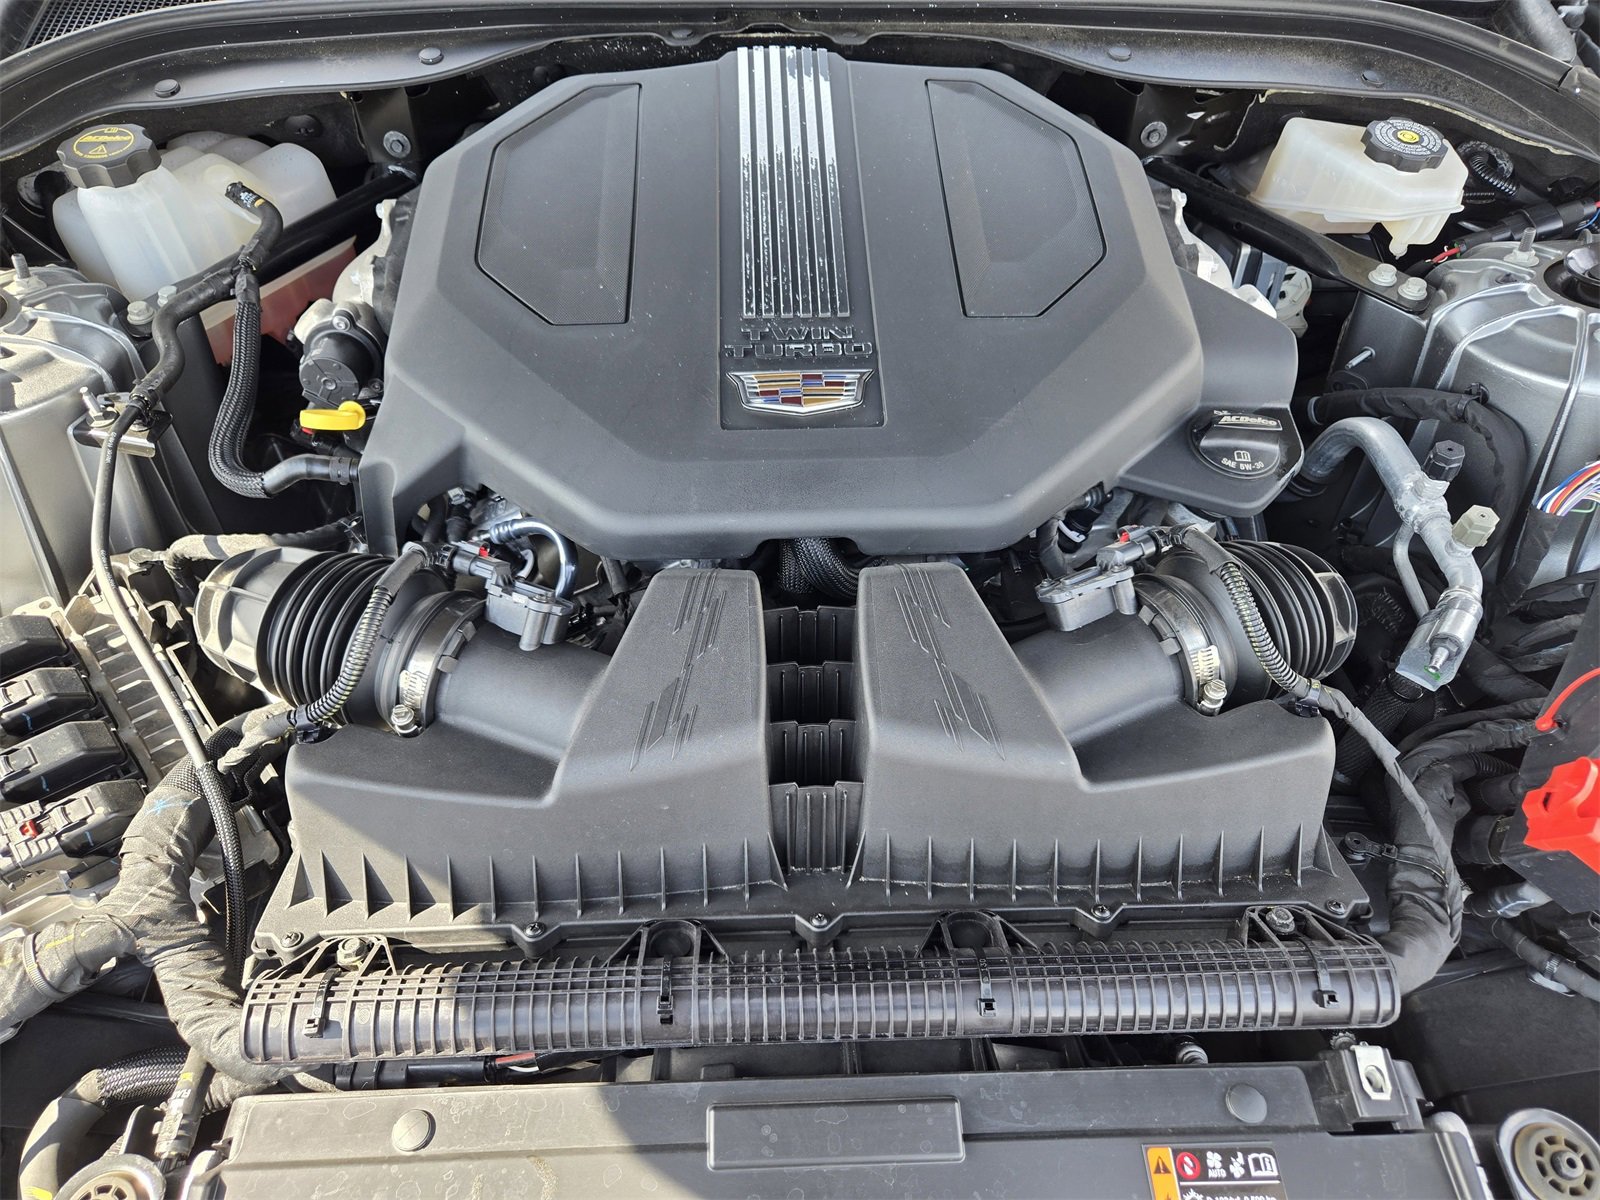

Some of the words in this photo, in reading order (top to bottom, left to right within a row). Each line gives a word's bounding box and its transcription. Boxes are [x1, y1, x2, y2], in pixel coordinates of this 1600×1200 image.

[741, 325, 853, 341] TWIN
[725, 342, 873, 357] TURBO
[1219, 415, 1278, 426] ACDelco
[1221, 457, 1237, 468] SAE
[1239, 460, 1265, 471] 5W-30
[1208, 1168, 1227, 1178] AUTO
